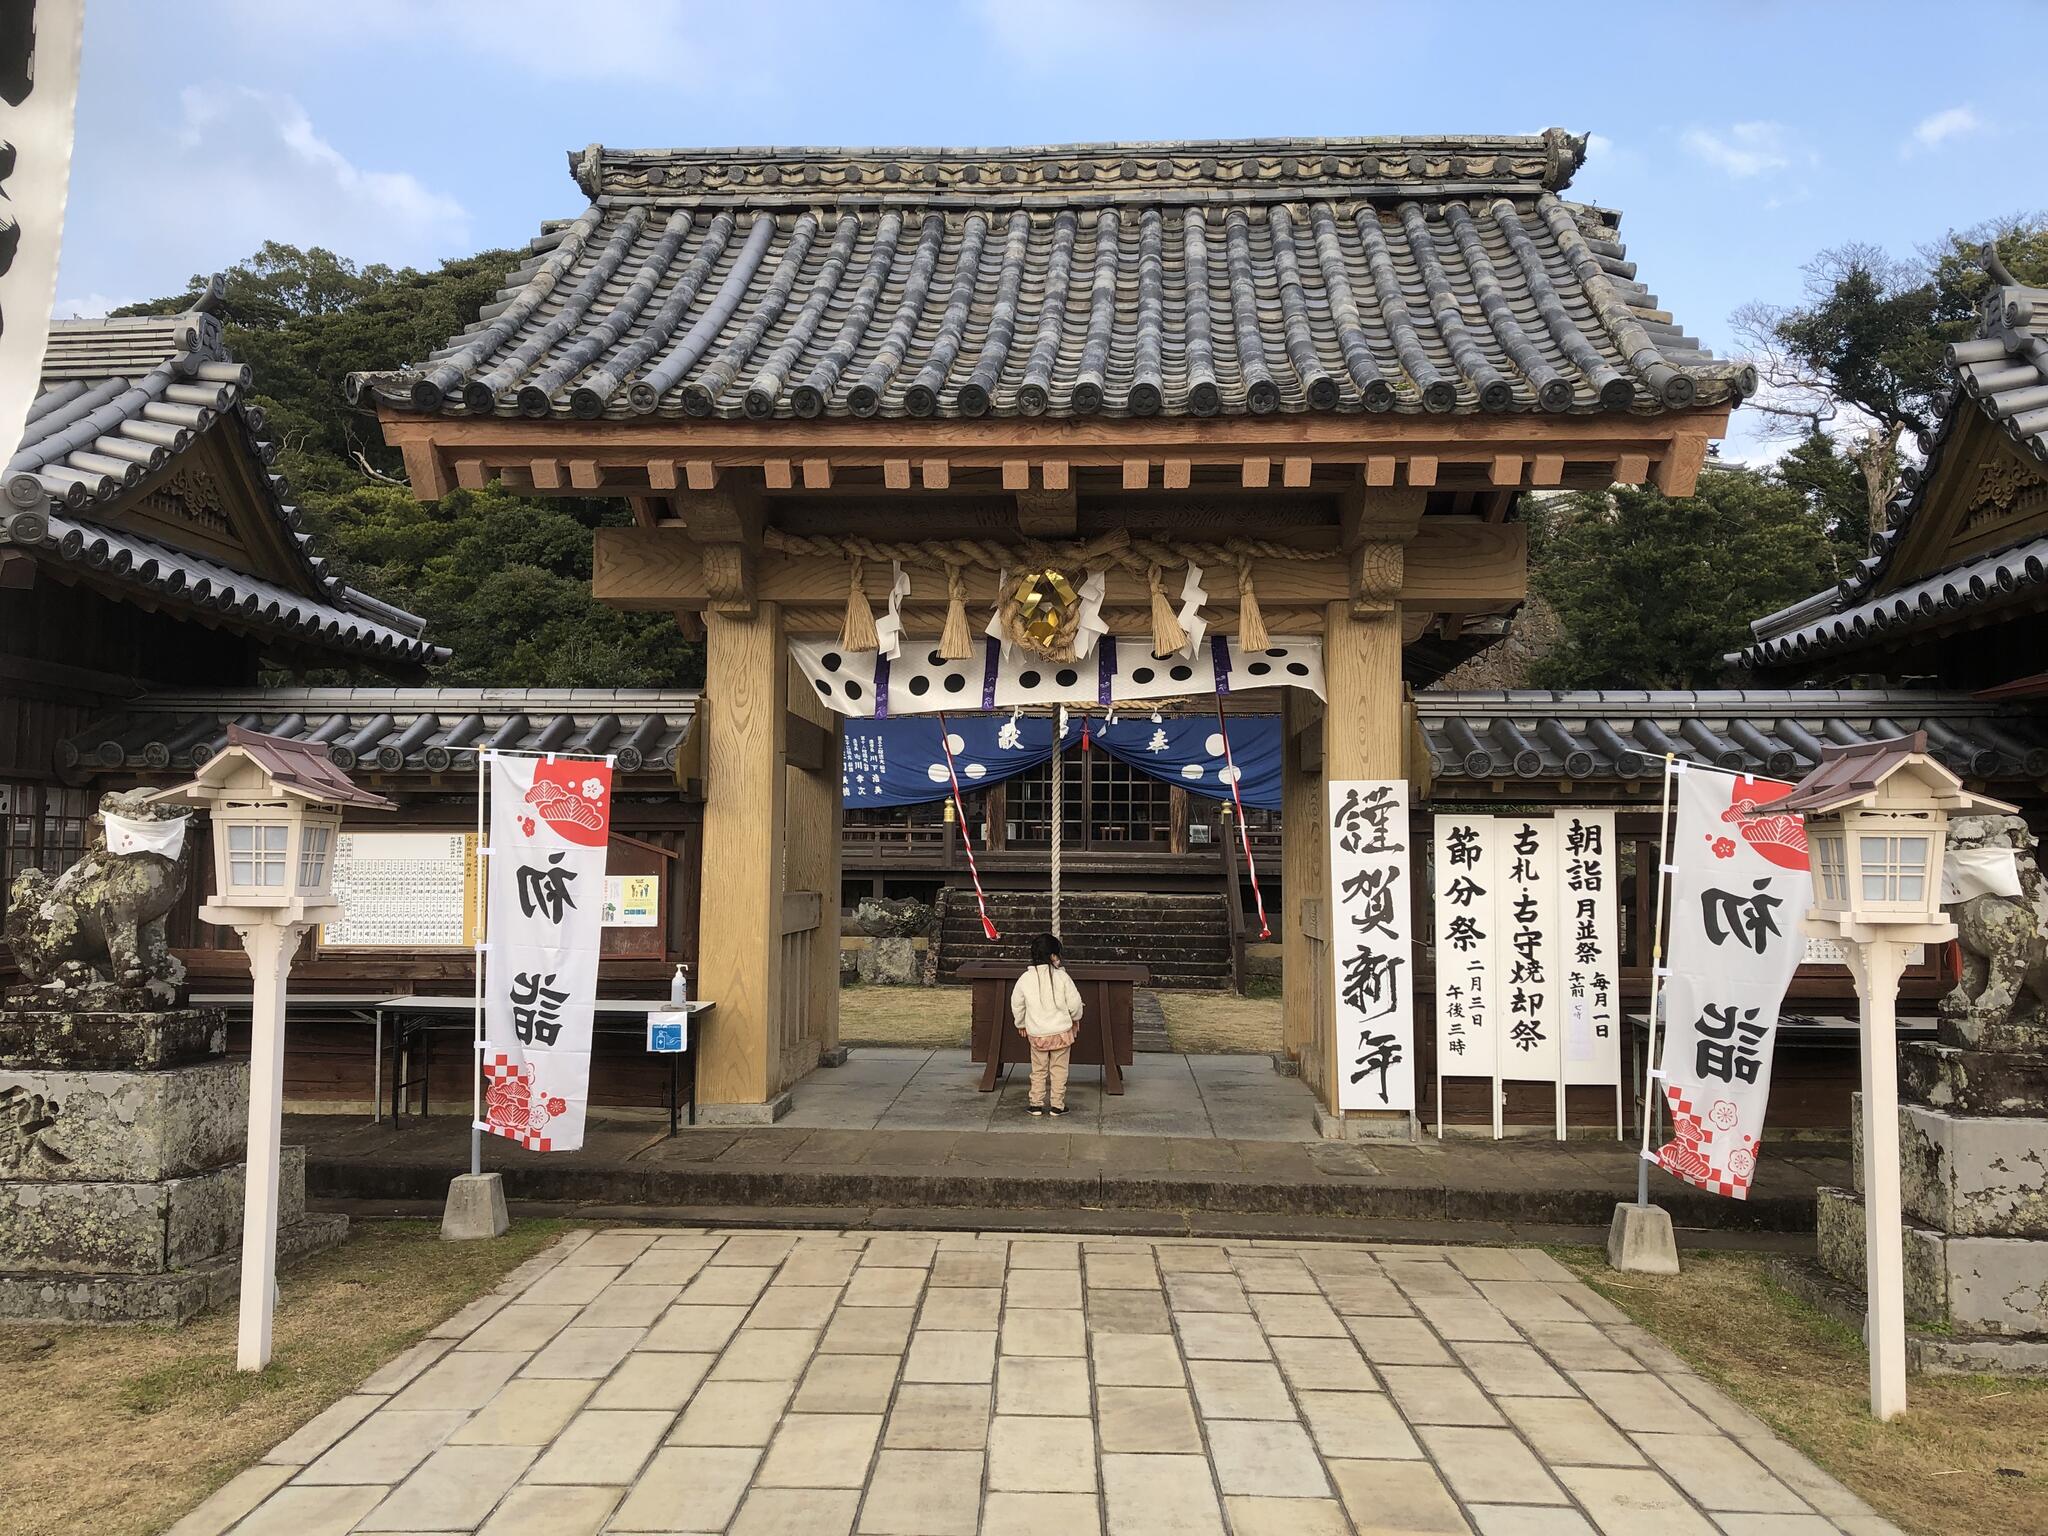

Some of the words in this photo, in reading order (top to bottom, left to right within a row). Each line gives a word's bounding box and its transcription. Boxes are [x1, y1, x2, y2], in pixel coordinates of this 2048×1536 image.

[1145, 728, 1170, 754] 奉
[1444, 825, 1487, 952] 節分祭
[1334, 786, 1405, 1105] 謹賀新年
[1466, 960, 1486, 1027] 二月三日
[1568, 971, 1586, 998] 午前
[1589, 971, 1611, 1039] 毎月一日
[1445, 984, 1466, 1056] 午後三時
